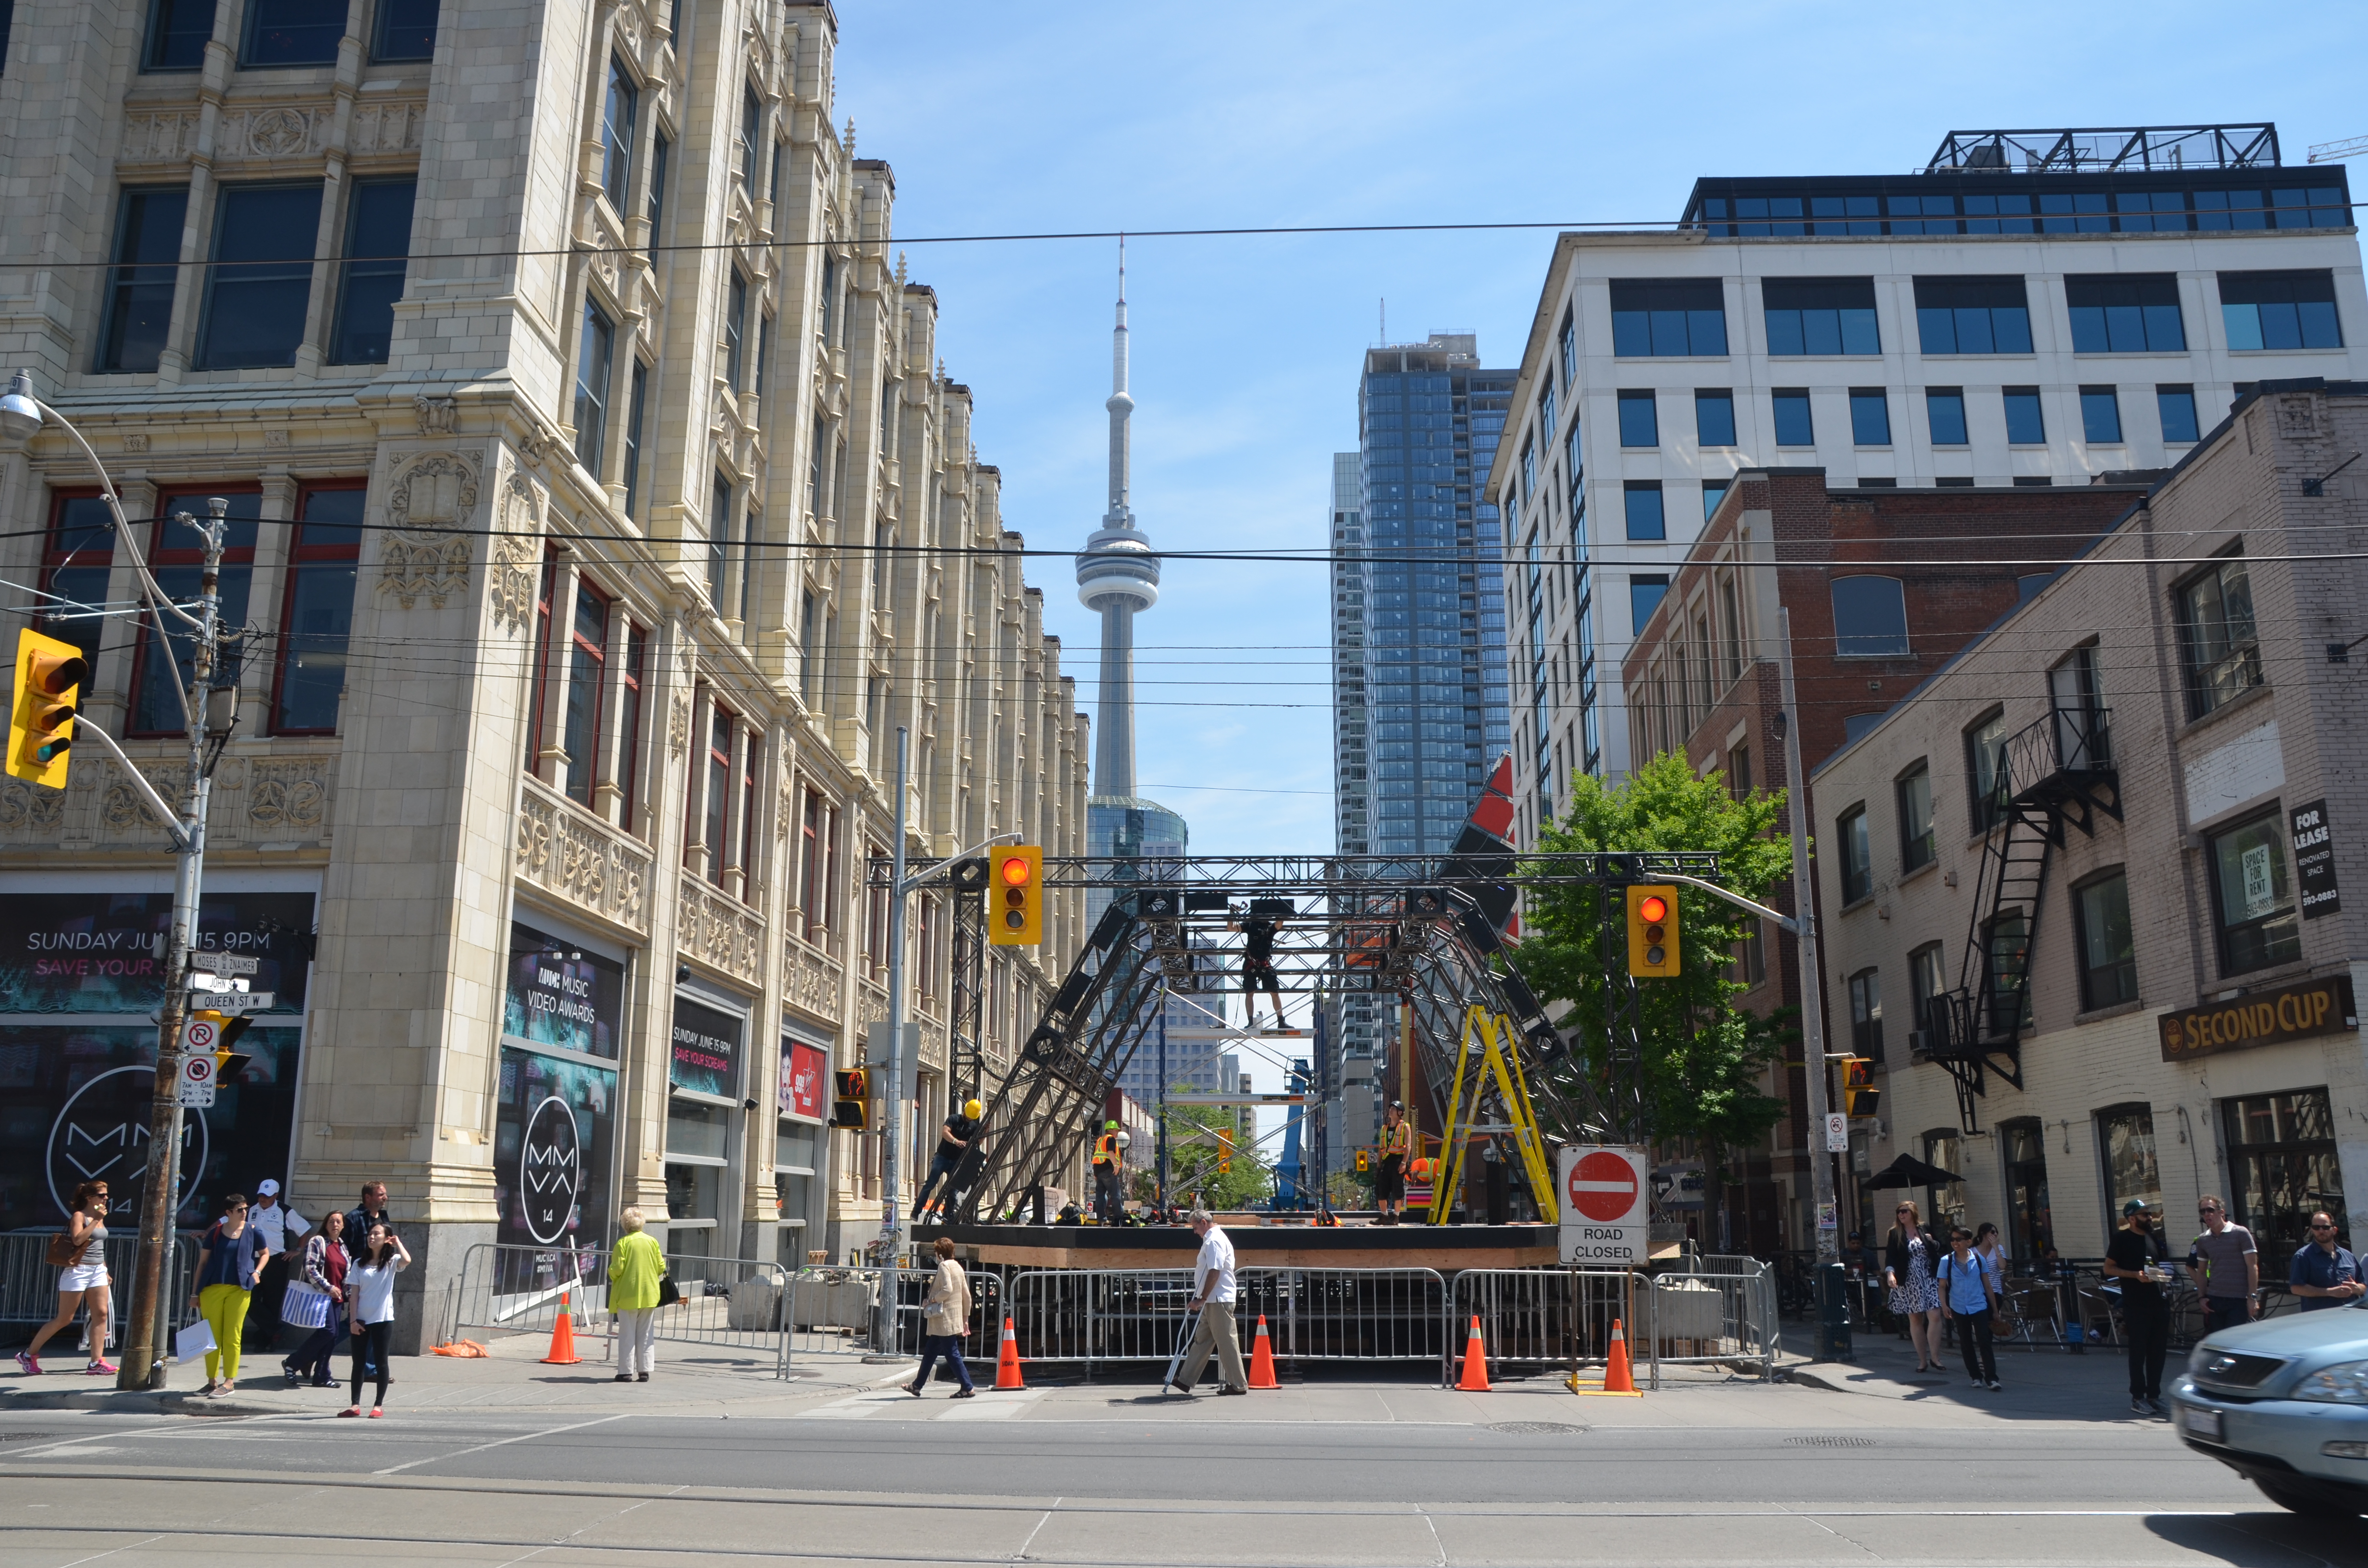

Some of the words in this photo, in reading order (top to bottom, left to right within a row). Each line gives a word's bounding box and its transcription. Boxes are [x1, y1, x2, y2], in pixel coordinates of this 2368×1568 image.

[2296, 810, 2320, 830] FOR
[2294, 826, 2329, 850] LEASE
[2245, 849, 2265, 869] SPACE
[2299, 850, 2330, 866] RENOVATED
[2250, 866, 2262, 882] FOR
[2307, 865, 2324, 877] SPACE
[2249, 879, 2266, 897] RENT
[2303, 889, 2337, 906] 593-0883
[2247, 896, 2273, 918] 593-0883
[27, 932, 122, 950] SUNDAY
[196, 932, 216, 949] 15
[224, 932, 270, 950] 9PM
[36, 959, 87, 976] SAVE
[97, 959, 153, 976] YOUR
[197, 956, 217, 968] MOSES
[230, 959, 255, 972] ZNAIMER
[210, 977, 226, 989] JOHN
[562, 975, 588, 998] MUSIC
[205, 996, 234, 1007] QUEEN
[238, 996, 249, 1006] ST
[253, 995, 260, 1006] W
[528, 989, 556, 1013] VIDEO
[557, 999, 595, 1024] AWARDS
[2185, 1003, 2276, 1049] SECOND
[2277, 991, 2331, 1032] CUP
[673, 1026, 698, 1045] SUNDAY
[698, 1034, 714, 1050] JUNE
[714, 1039, 720, 1052] 15
[720, 1041, 731, 1055] 9PM
[675, 1047, 689, 1062] SAVE
[690, 1051, 704, 1066] YOUR
[705, 1055, 728, 1071] SCREAMS
[108, 1198, 132, 1213] 14
[543, 1209, 553, 1223] 14
[1584, 1228, 1623, 1240] ROAD
[1575, 1246, 1632, 1258] CLOSED
